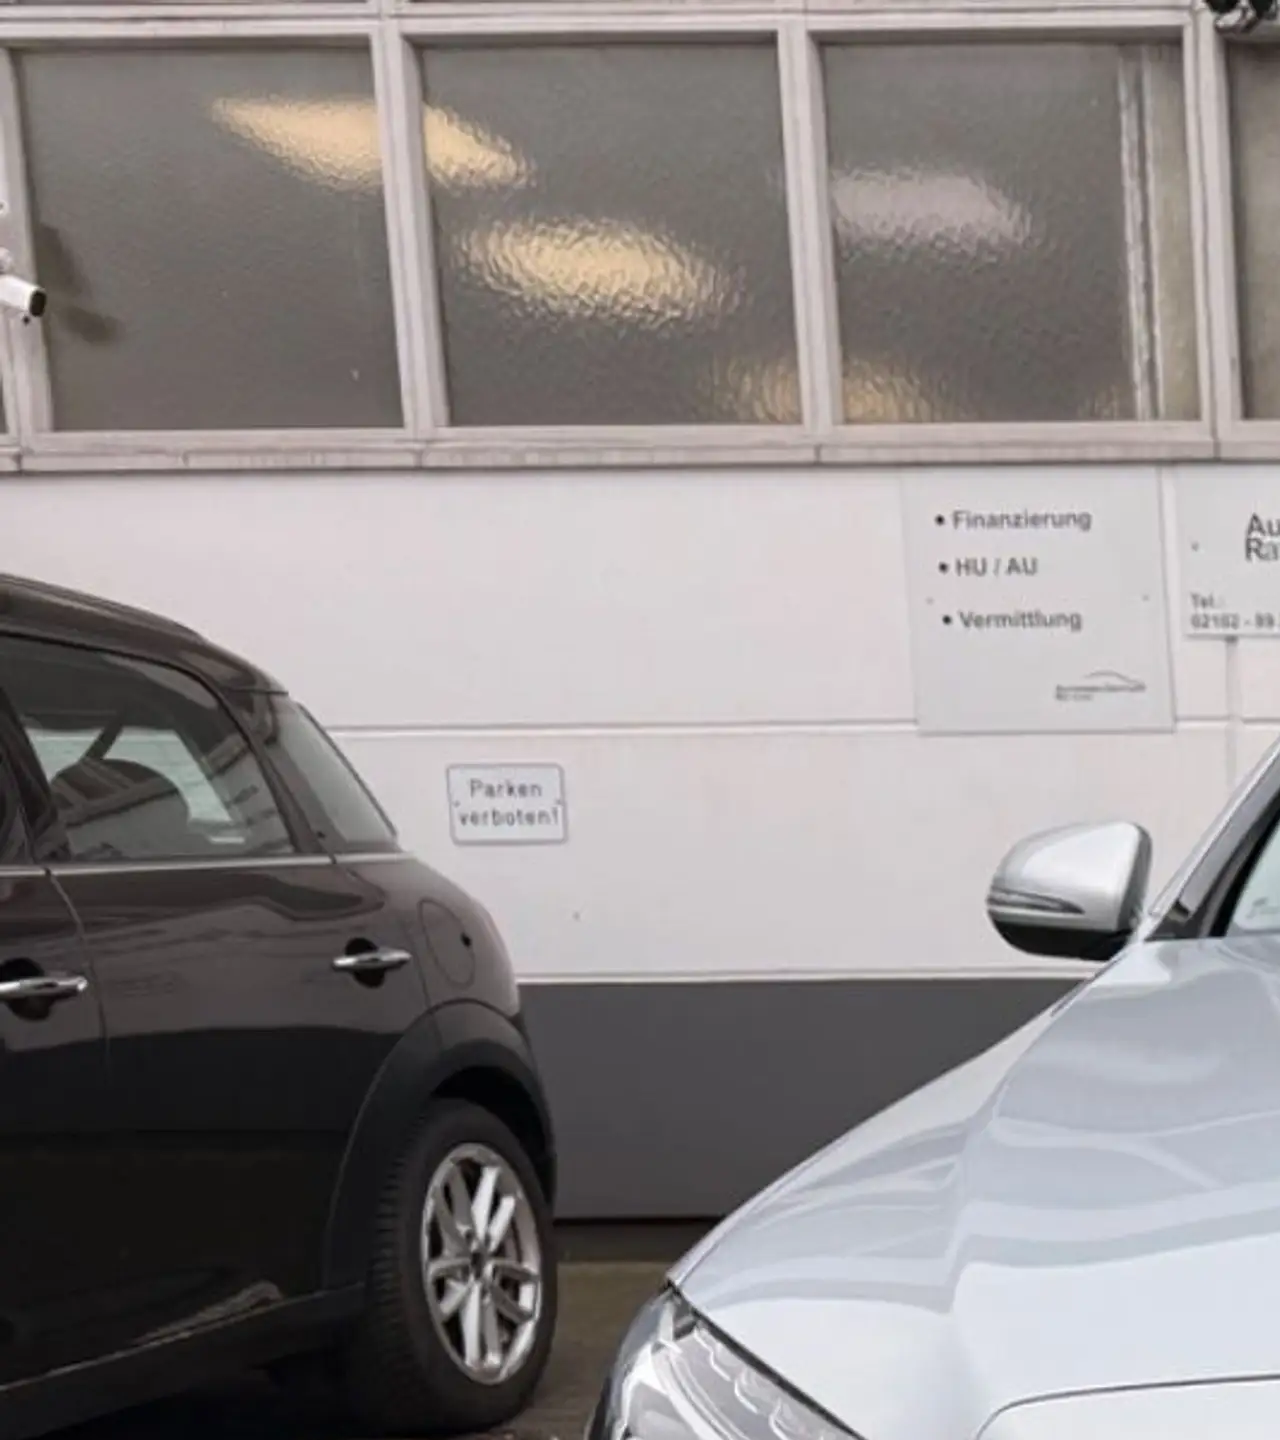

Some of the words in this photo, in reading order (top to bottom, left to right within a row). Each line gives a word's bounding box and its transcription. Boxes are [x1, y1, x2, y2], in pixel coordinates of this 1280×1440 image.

[952, 510, 1092, 532] Finanzierung
[955, 557, 987, 576] HU
[993, 557, 1001, 577] /
[1007, 557, 1037, 576] AU
[958, 611, 1082, 632] Vermittlung
[470, 778, 543, 799] Parken
[459, 806, 559, 827] verboten!
